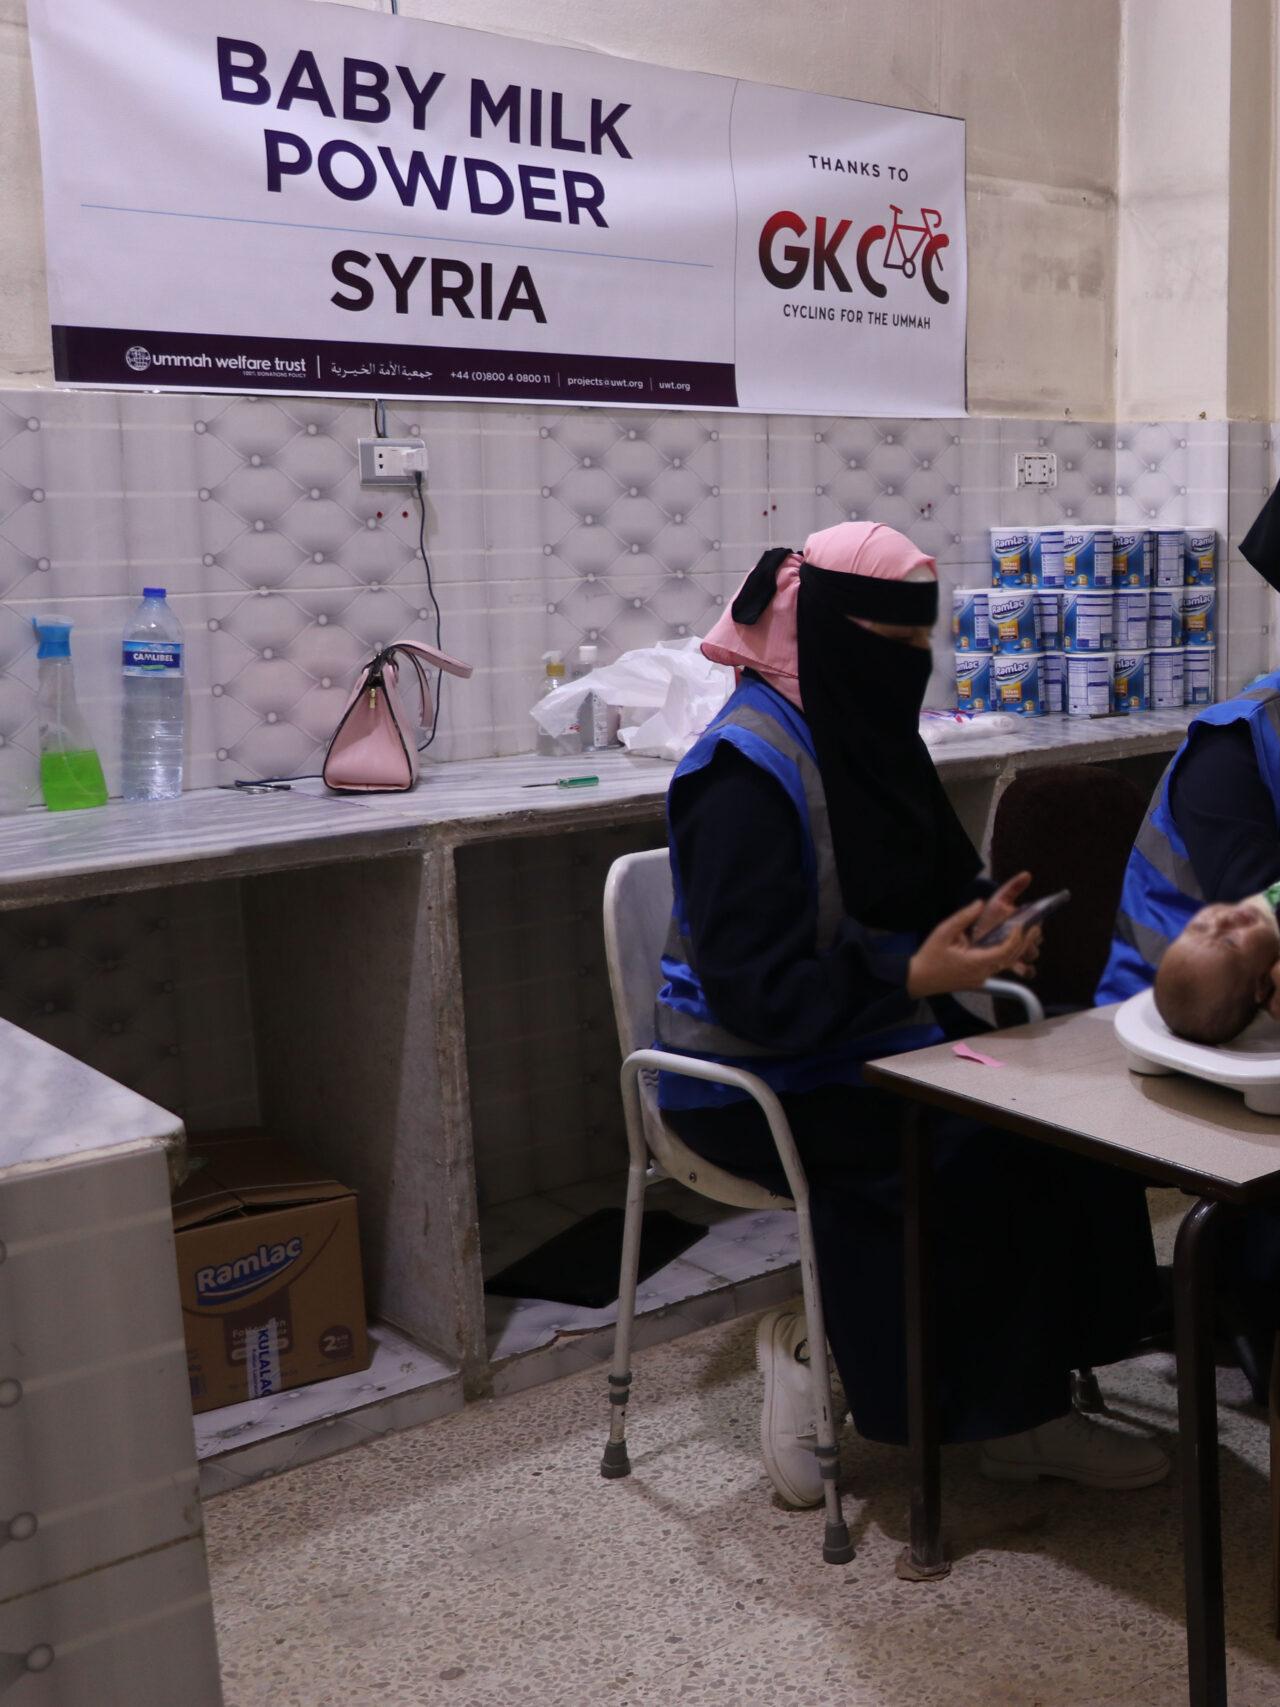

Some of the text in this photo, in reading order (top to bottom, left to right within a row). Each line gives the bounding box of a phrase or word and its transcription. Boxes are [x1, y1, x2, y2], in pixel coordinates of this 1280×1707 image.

[217, 36, 633, 159] BABY MILK
[264, 129, 609, 228] POWDER
[809, 155, 909, 182] THANKS TO
[330, 249, 547, 324] SYRIA
[783, 304, 931, 330] CYCLING FOR THE UMMAH
[152, 353, 306, 373] ummah welfare trust
[379, 361, 401, 376] الأمة
[402, 365, 433, 381] جمعية
[450, 371, 551, 384] +44 (0)800 4 0800 11
[658, 380, 692, 393] uwt.org
[197, 1238, 301, 1292] Ramlac
[323, 1335, 337, 1352] 2
